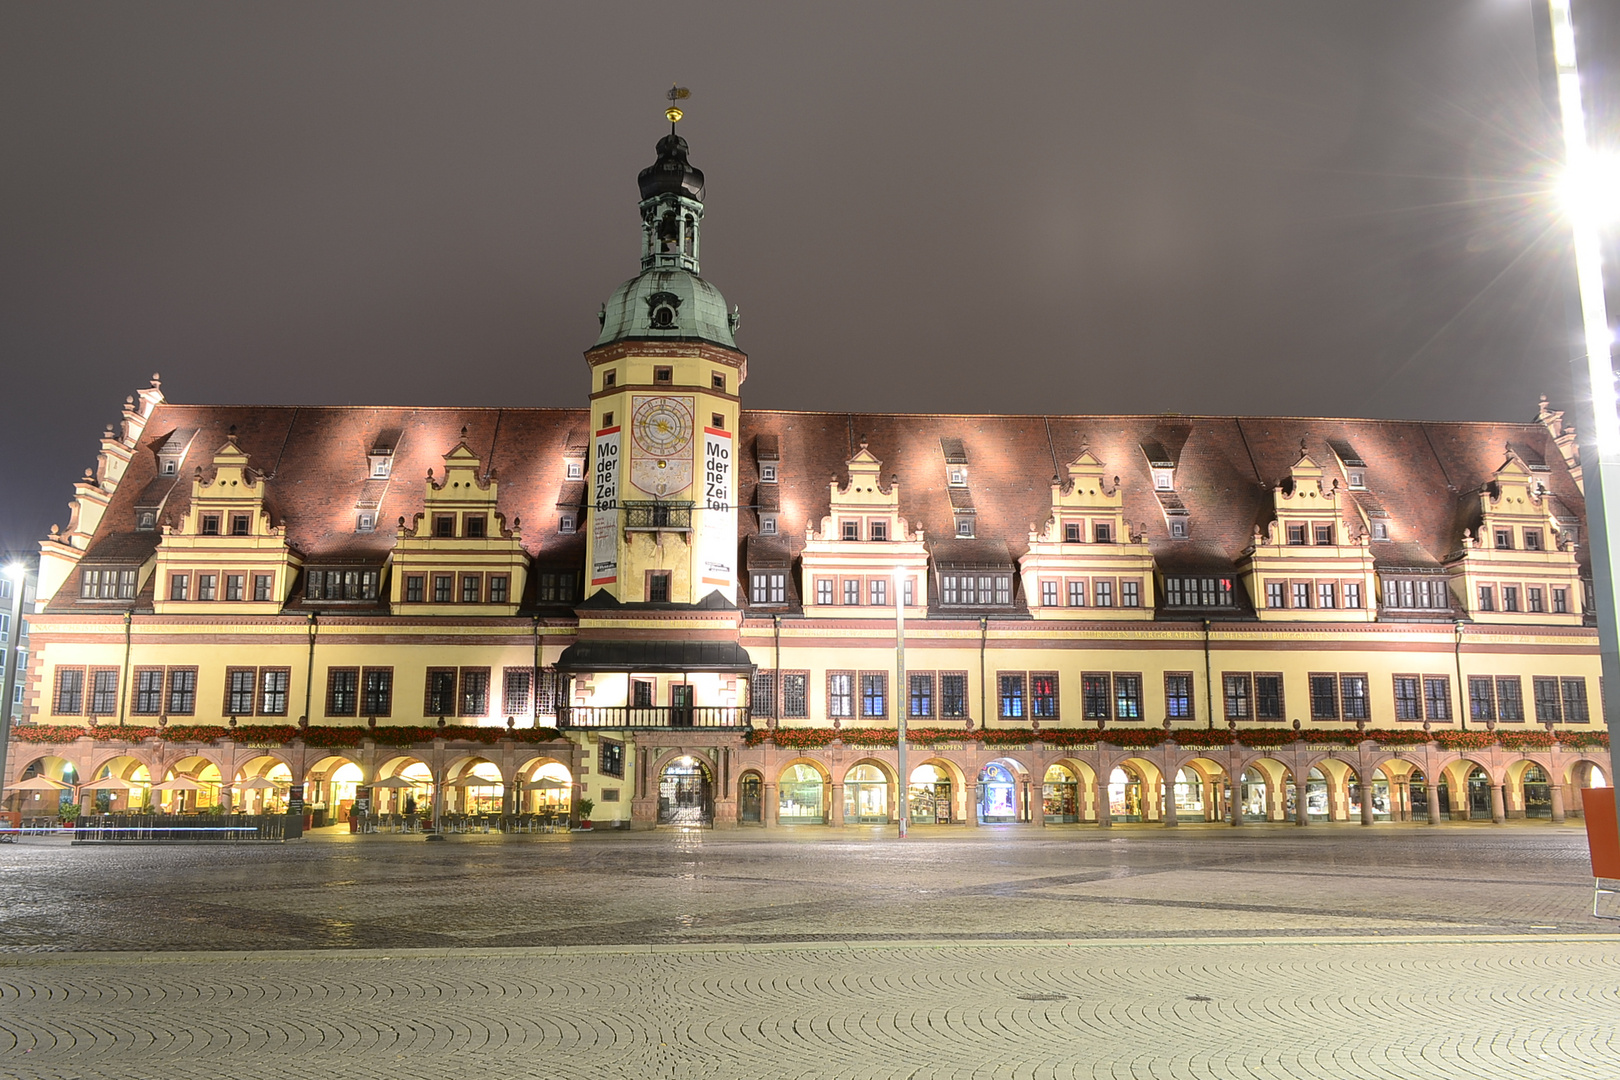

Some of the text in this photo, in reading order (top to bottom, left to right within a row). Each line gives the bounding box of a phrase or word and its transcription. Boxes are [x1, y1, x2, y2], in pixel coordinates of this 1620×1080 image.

[598, 443, 618, 458] Mo
[707, 442, 729, 459] Mo
[597, 458, 618, 473] der
[707, 457, 729, 474] der
[597, 472, 612, 484] ne
[707, 471, 723, 484] ne
[596, 482, 615, 499] Zei
[706, 482, 727, 499] Zei
[596, 499, 617, 512] ten
[706, 497, 729, 512] ten
